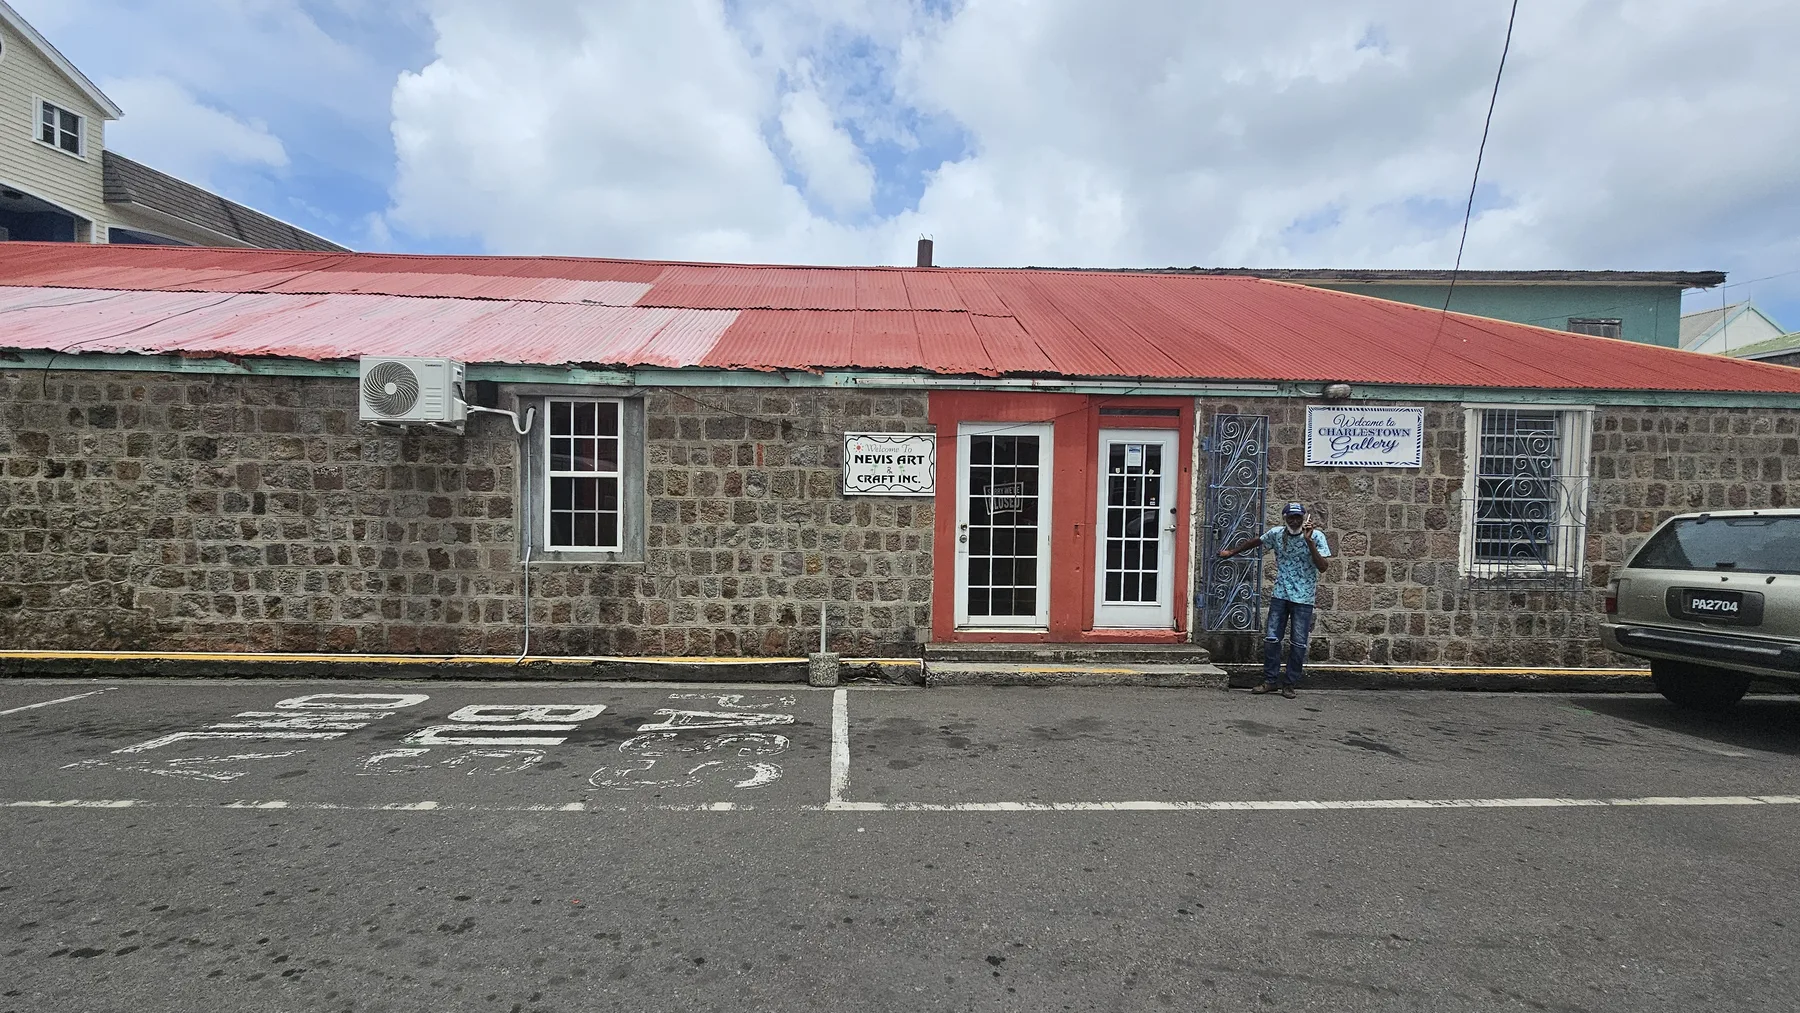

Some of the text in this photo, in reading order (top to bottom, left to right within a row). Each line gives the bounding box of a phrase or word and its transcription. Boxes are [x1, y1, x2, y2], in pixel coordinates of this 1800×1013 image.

[1333, 413, 1397, 428] Welcome to
[1318, 427, 1412, 437] CHARLESTOWN
[865, 443, 913, 453] Welcome To
[1329, 435, 1400, 459] Gallery
[854, 454, 925, 466] NEVIS ART
[886, 466, 893, 474] &
[857, 474, 921, 484] CRAFT INC.
[1691, 598, 1739, 612] PA2704
[354, 704, 607, 775] BUS
